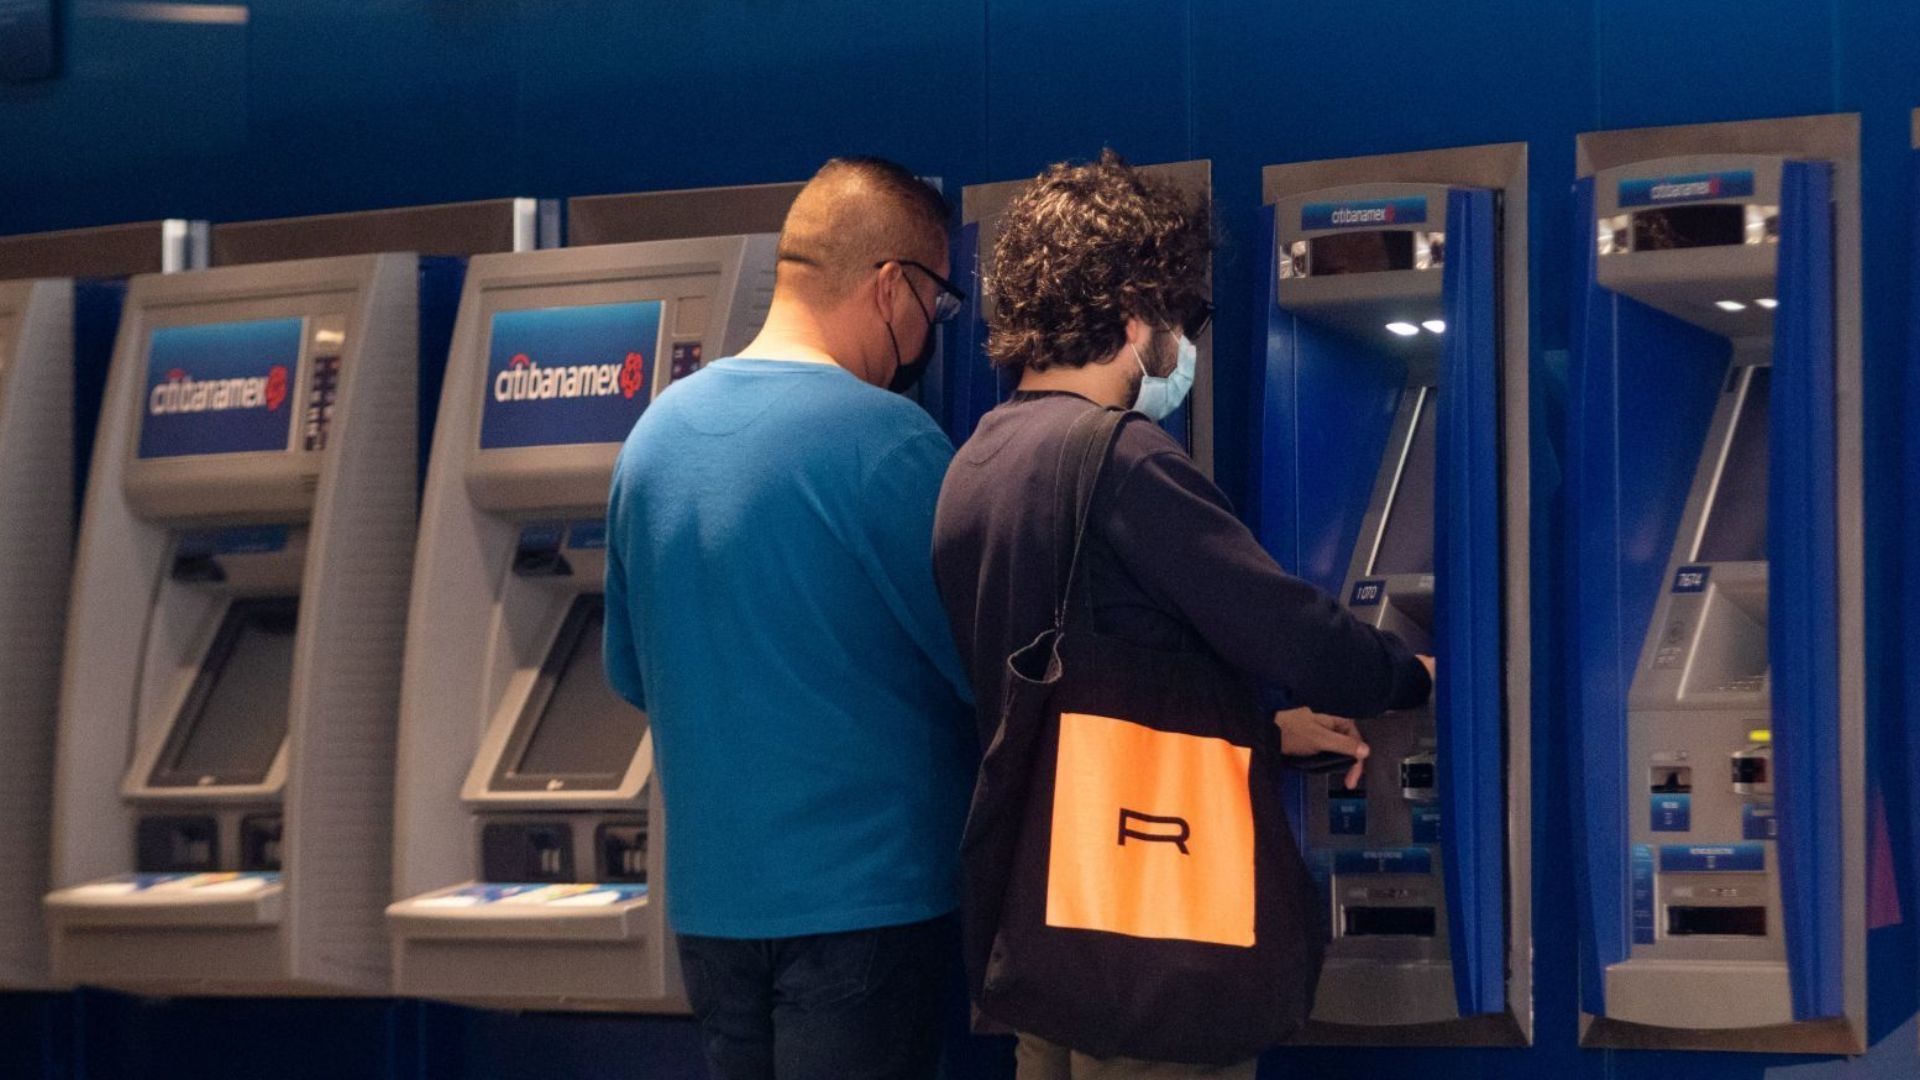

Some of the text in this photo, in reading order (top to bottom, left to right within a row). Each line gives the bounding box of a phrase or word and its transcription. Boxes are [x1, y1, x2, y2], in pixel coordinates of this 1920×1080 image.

[1331, 205, 1385, 224] citibanamex
[150, 372, 268, 415] citibanamex
[495, 361, 622, 402] citibanamex
[1117, 808, 1191, 856] R
